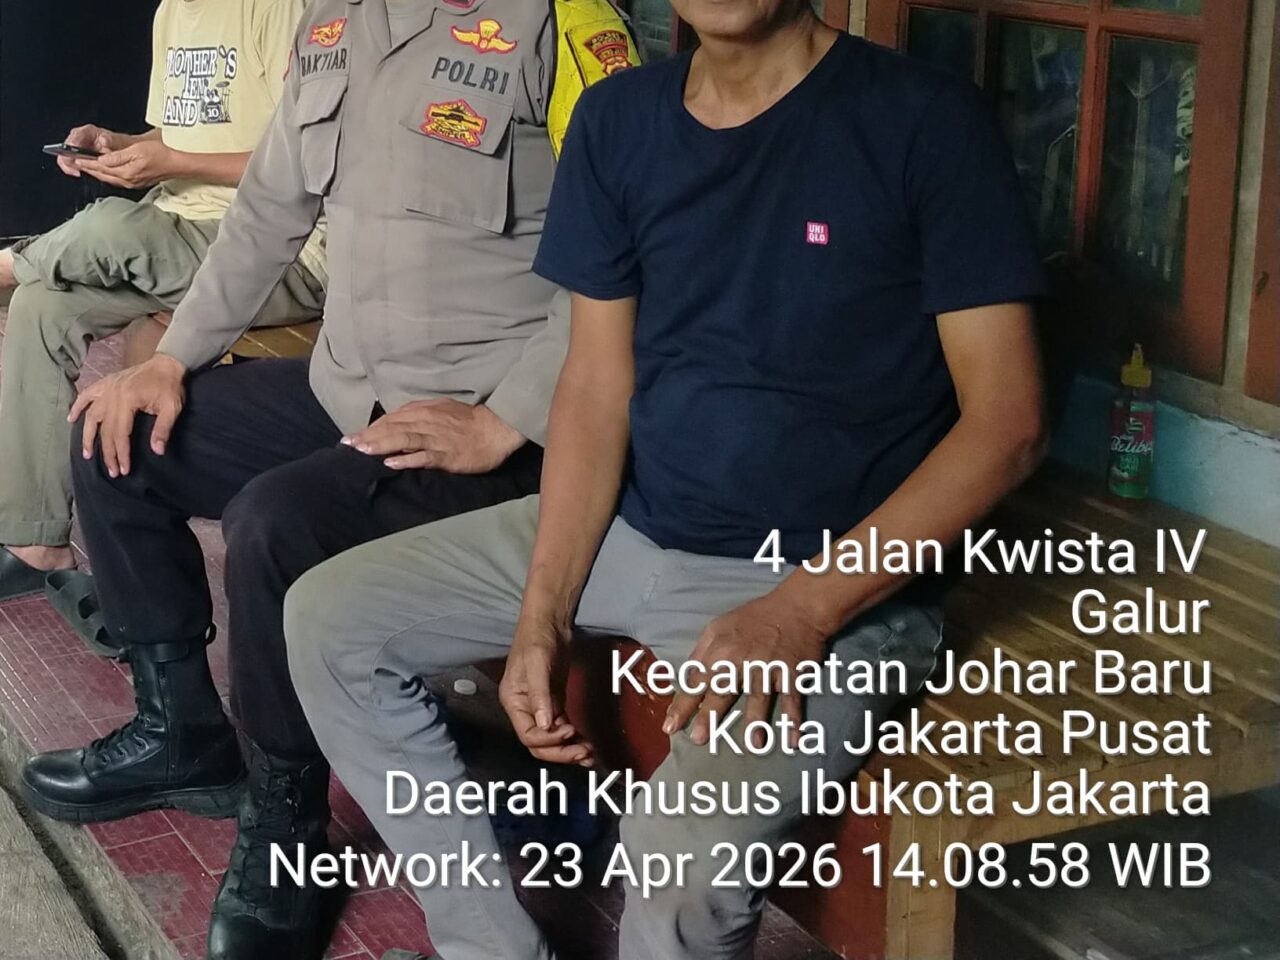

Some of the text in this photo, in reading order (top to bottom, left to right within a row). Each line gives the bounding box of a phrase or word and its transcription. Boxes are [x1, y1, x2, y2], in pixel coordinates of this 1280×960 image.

[300, 47, 348, 78] BAKTIAR
[431, 57, 511, 96] POLRI
[206, 107, 219, 117] 10
[809, 224, 824, 234] UNI
[809, 232, 825, 243] QLO
